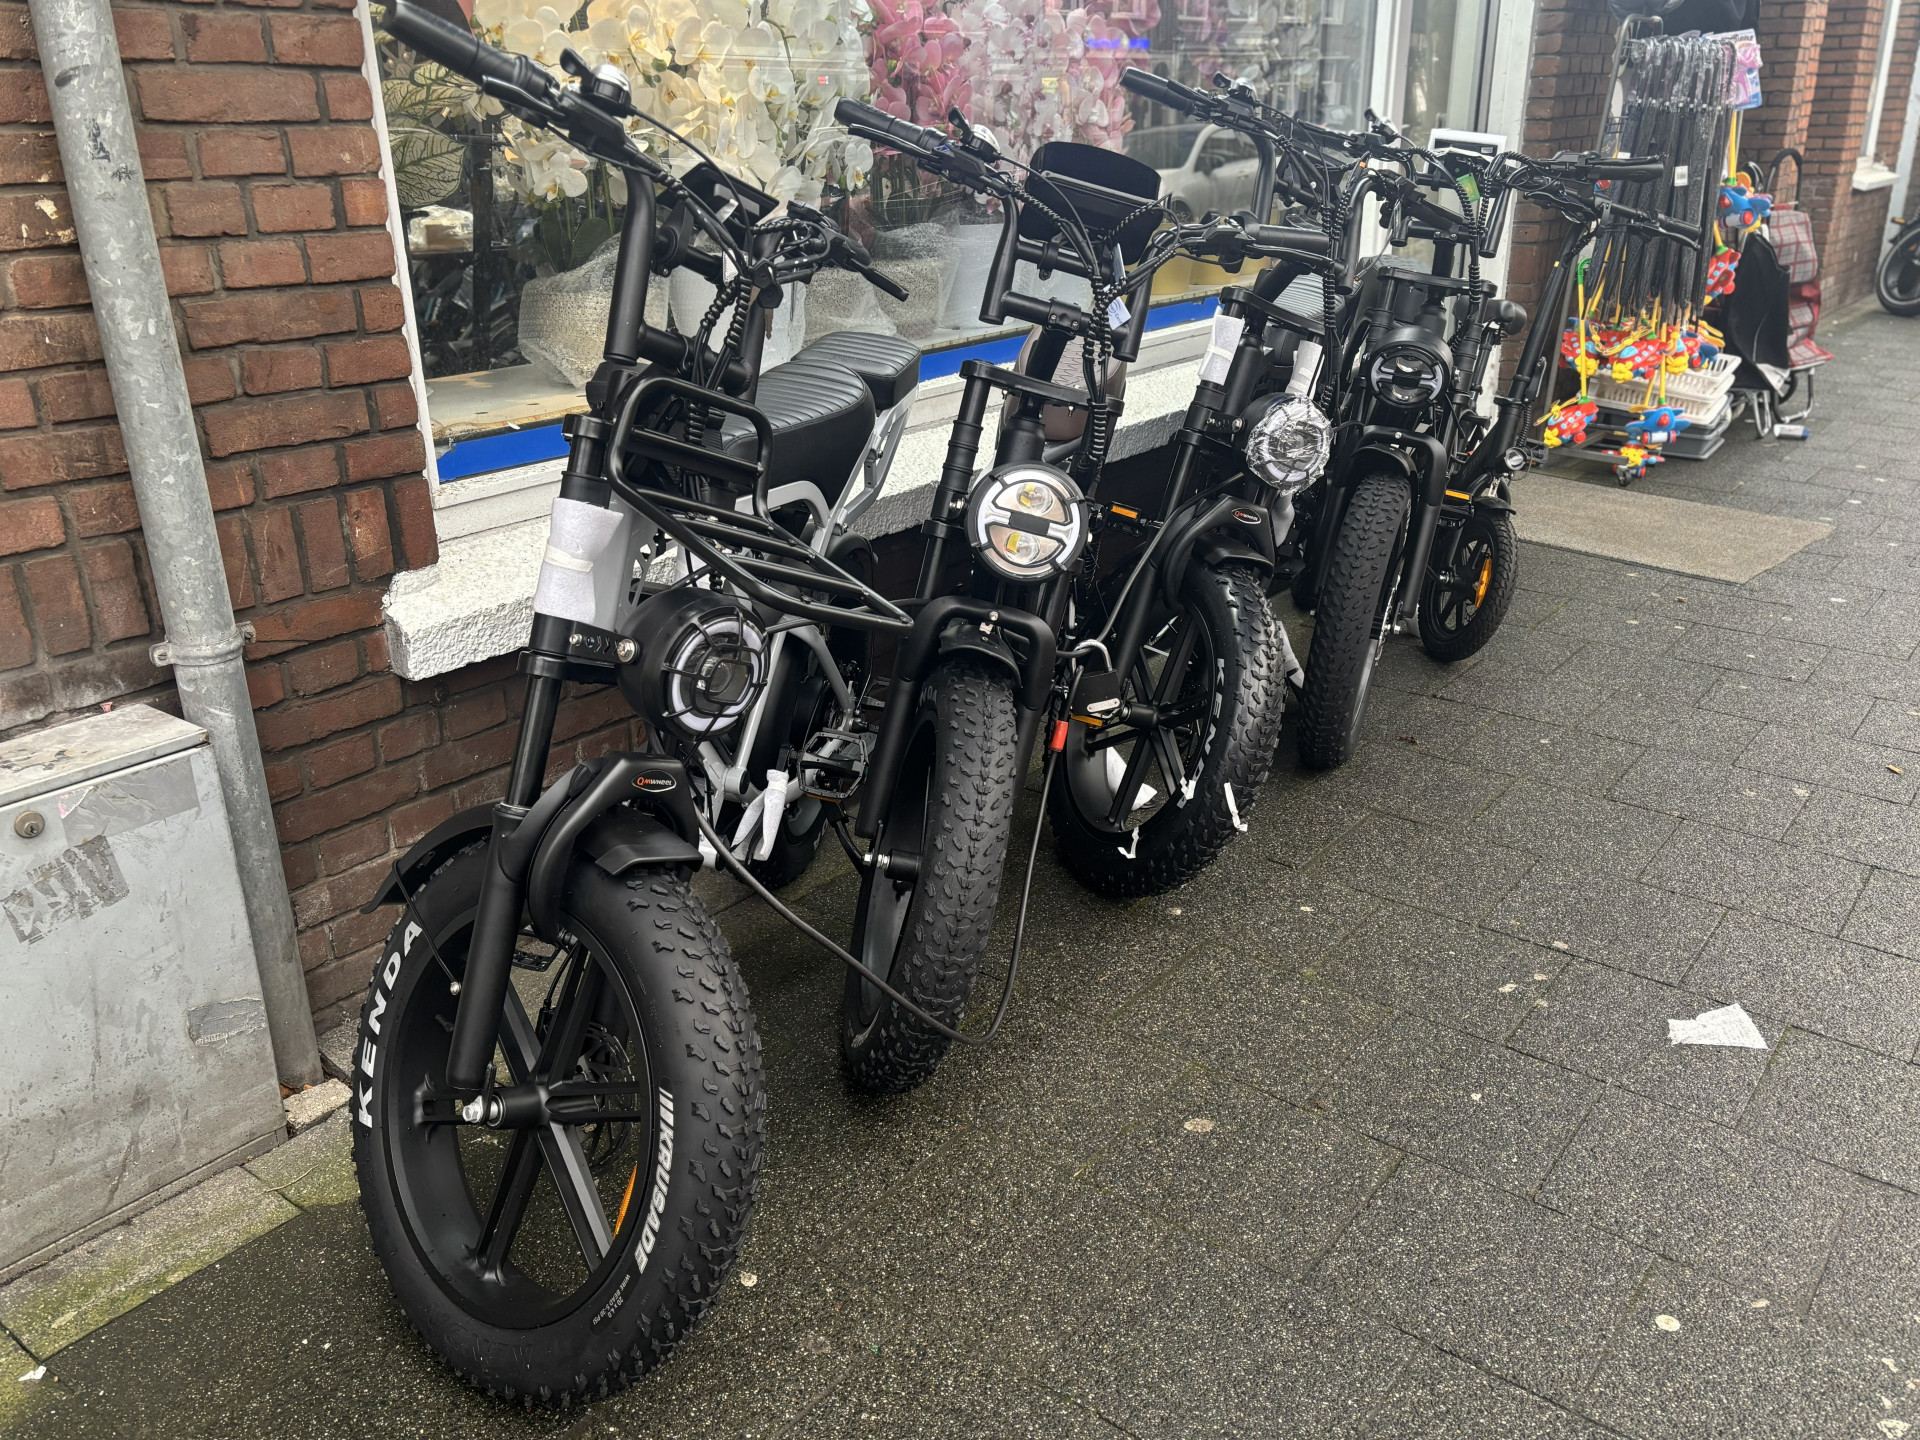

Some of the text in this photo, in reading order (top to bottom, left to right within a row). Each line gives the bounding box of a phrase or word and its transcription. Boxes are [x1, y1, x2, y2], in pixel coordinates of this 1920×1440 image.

[358, 920, 423, 1129] KENDA
[634, 1119, 674, 1275] KRUSADE
[619, 1273, 631, 1292] WIRE
[608, 1289, 621, 1307] BEAD
[616, 1296, 624, 1306] 20
